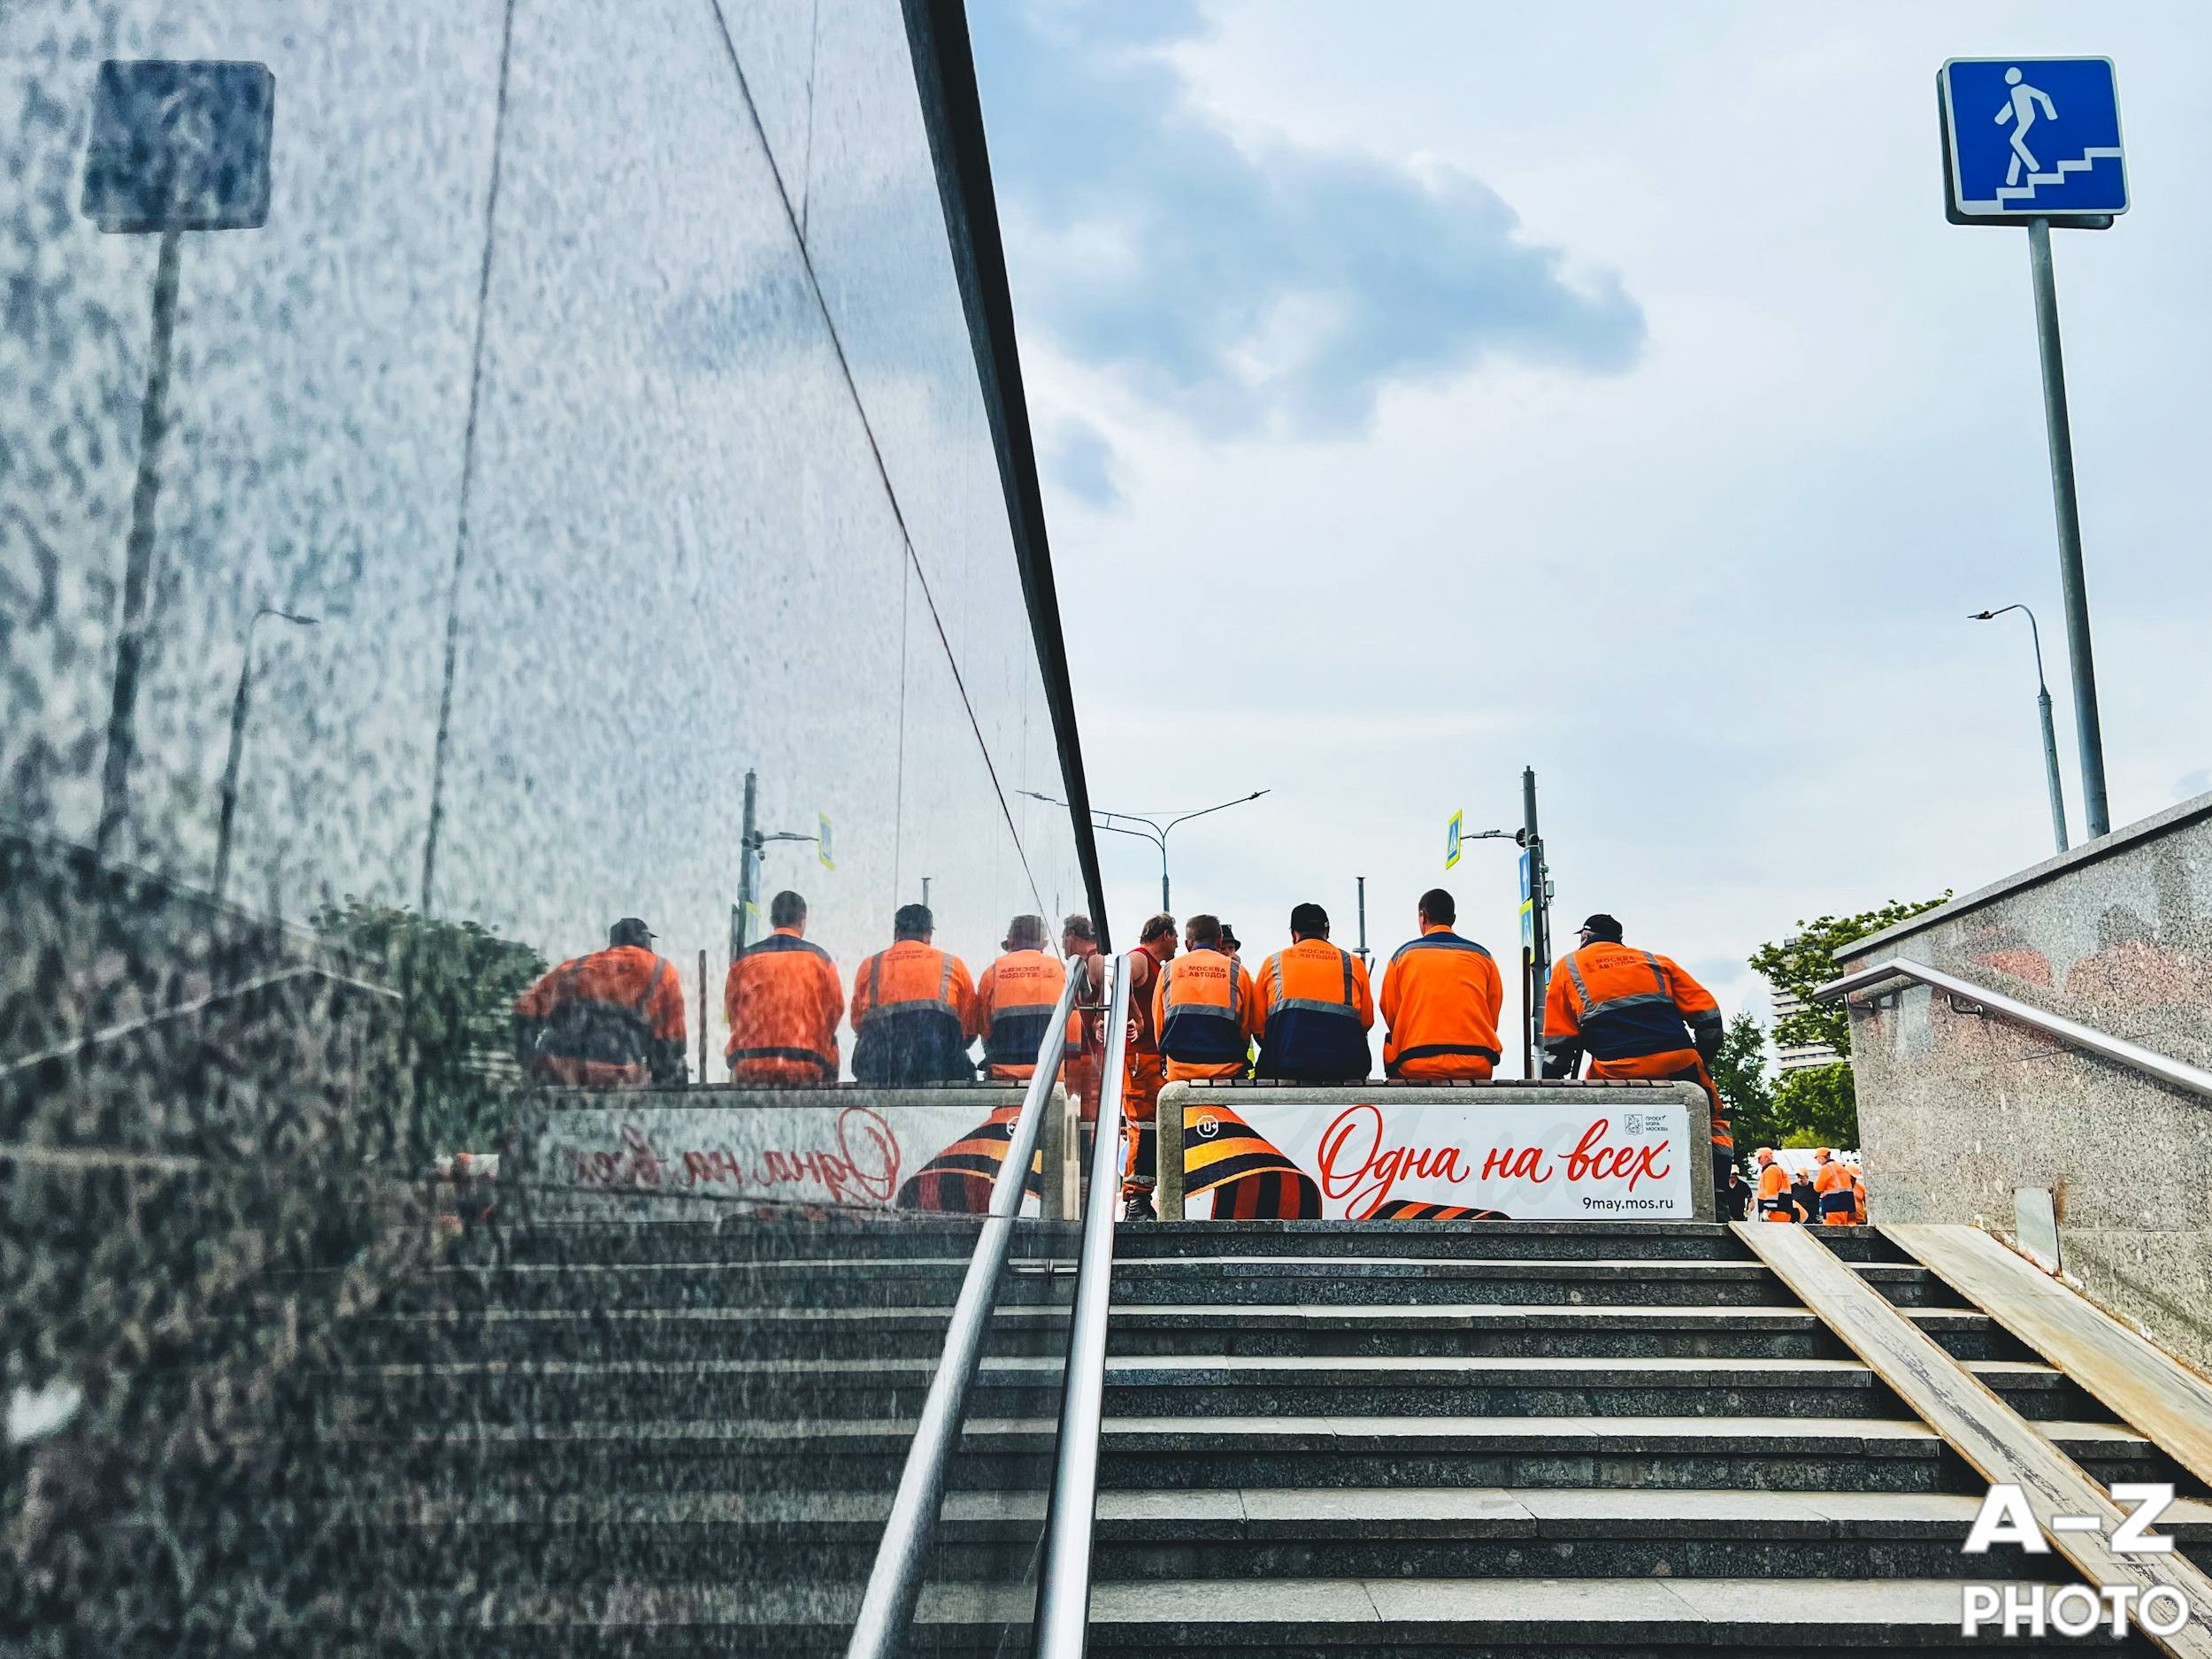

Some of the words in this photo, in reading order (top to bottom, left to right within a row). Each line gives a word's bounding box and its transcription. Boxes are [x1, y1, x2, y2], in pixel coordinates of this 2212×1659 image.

[1318, 1104, 1470, 1221] Одна
[1481, 1147, 1553, 1184] на
[1558, 1118, 1671, 1193] всех
[1583, 1197, 1674, 1211] 9may.mos.ru
